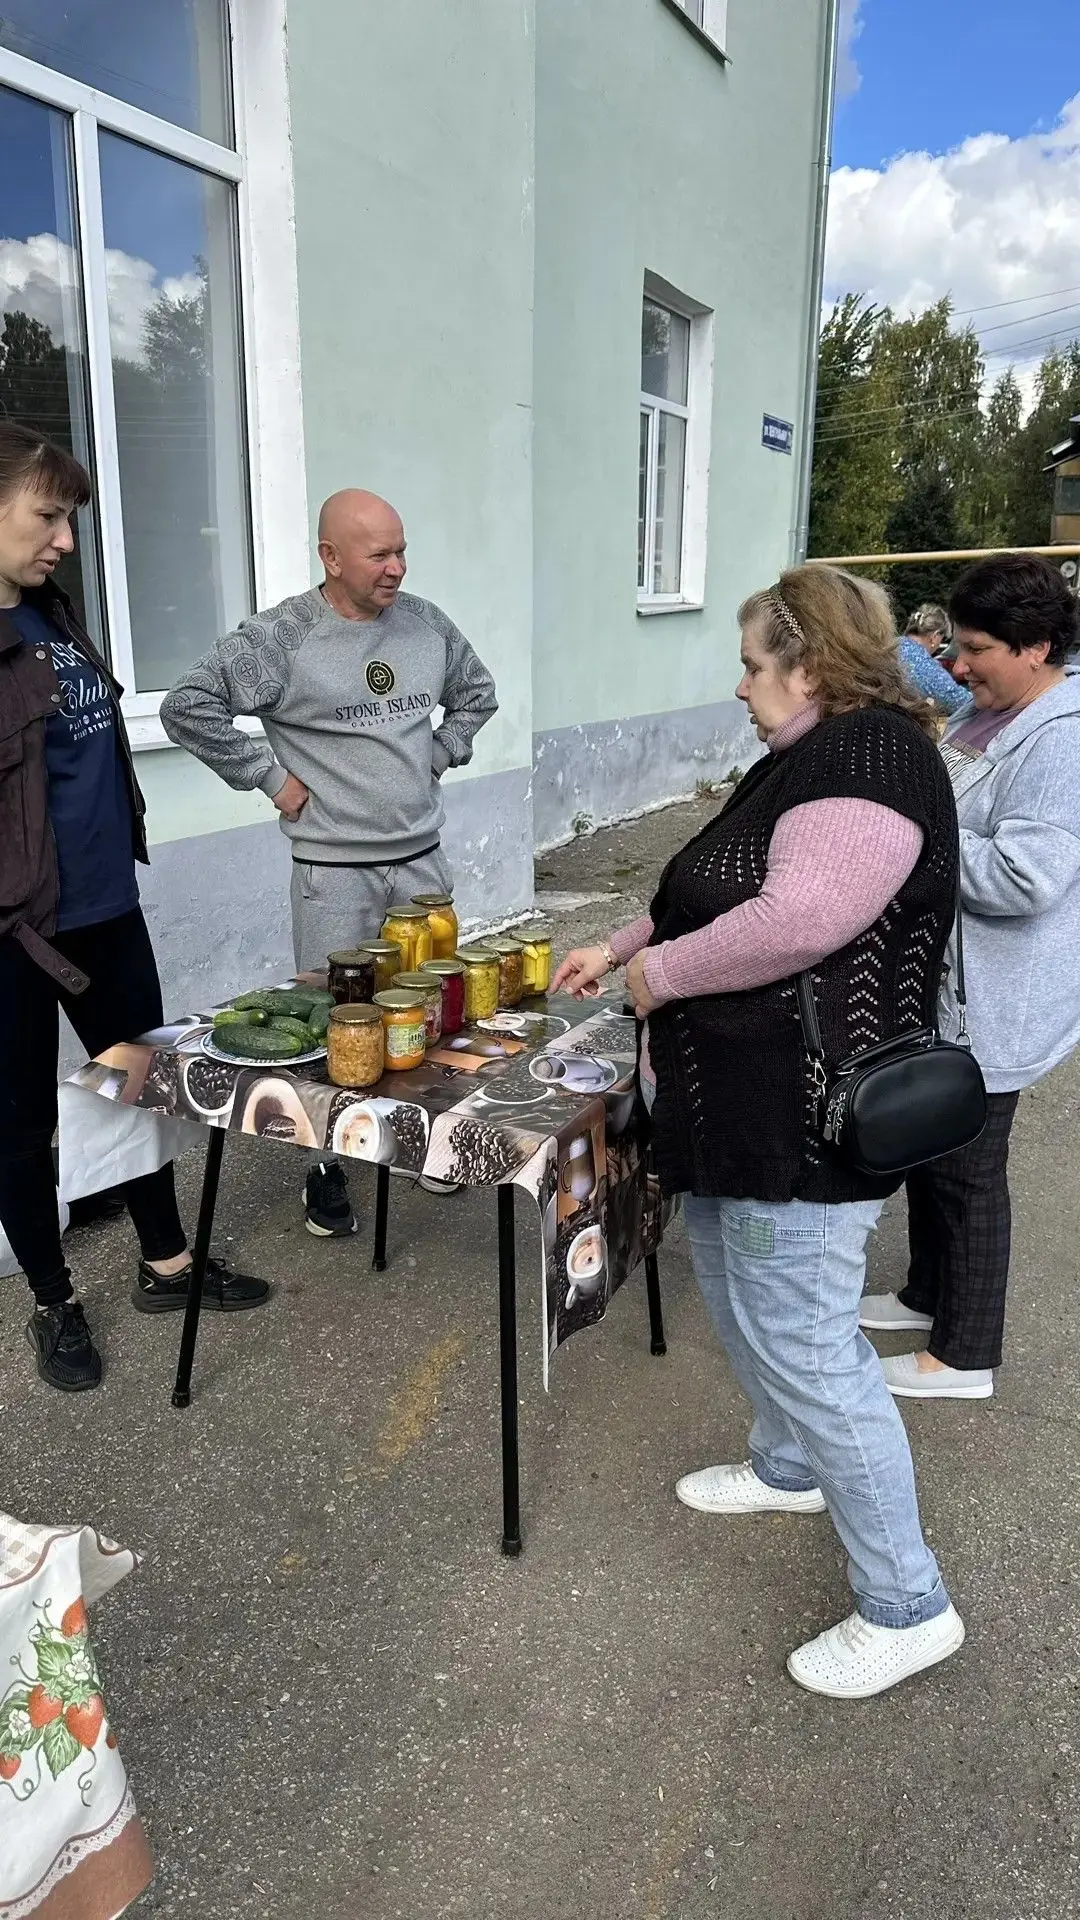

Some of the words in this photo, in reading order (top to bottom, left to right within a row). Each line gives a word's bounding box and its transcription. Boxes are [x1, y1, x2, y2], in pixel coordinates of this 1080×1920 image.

[58, 672, 108, 718] Club
[335, 702, 382, 720] STONE
[386, 693, 431, 713] ISLAND
[351, 711, 423, 728] CALIFORNIA
